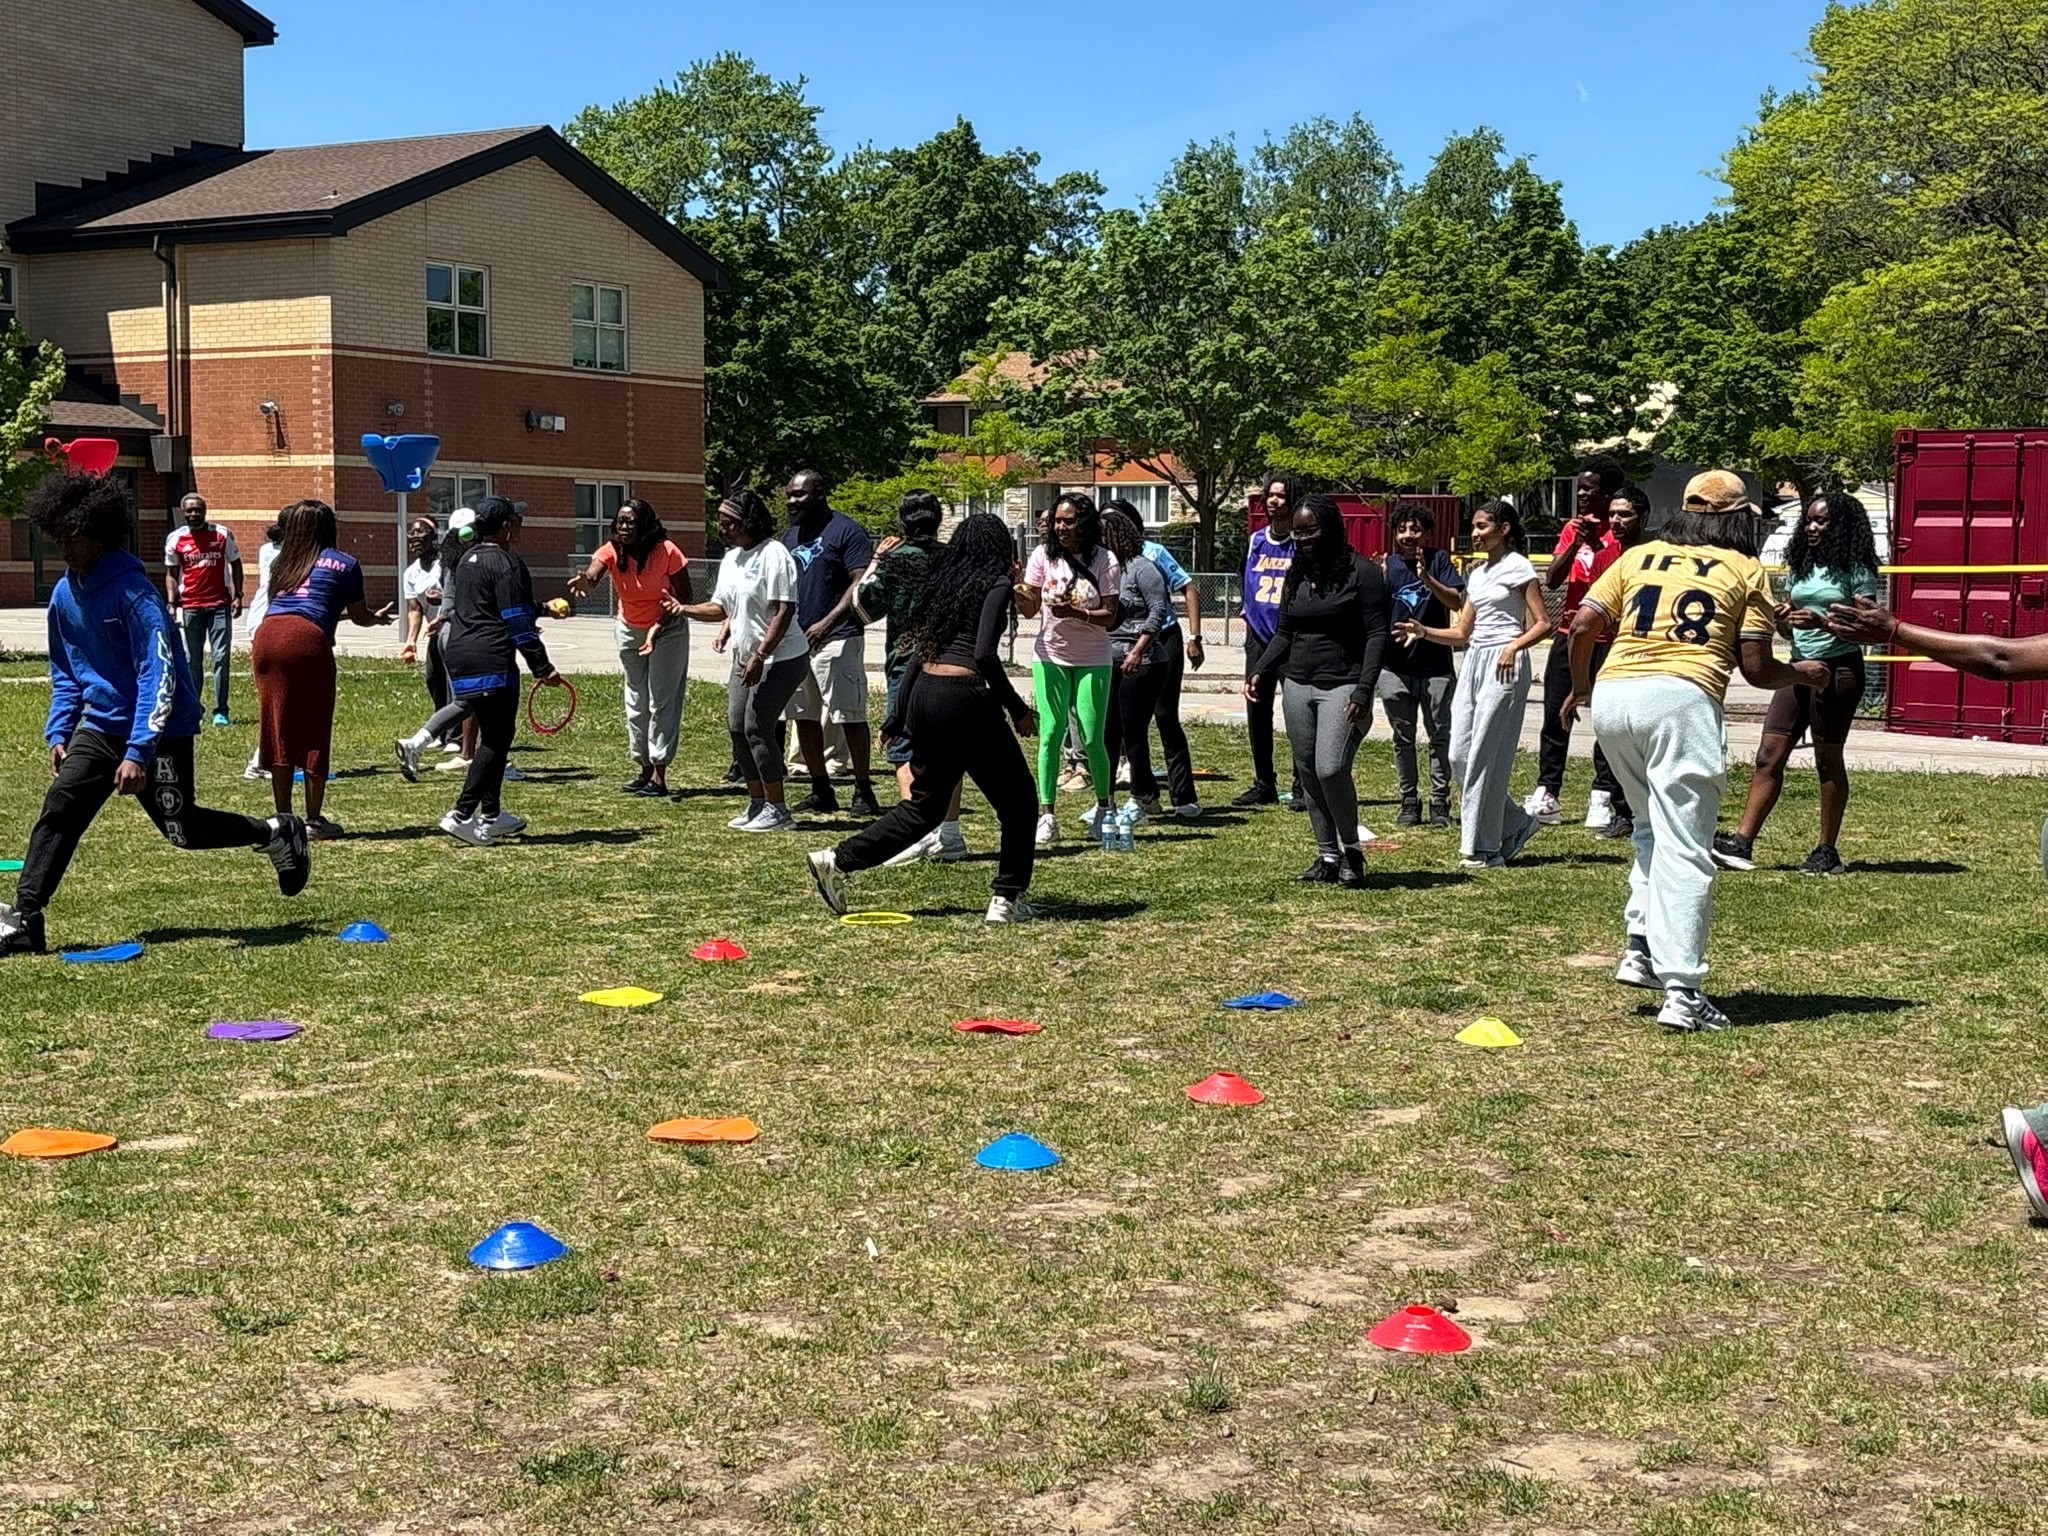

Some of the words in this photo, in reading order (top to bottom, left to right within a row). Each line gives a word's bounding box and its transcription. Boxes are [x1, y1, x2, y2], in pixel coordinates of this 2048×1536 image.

[183, 551, 222, 562] Emirates
[1639, 553, 1722, 577] IFY
[1630, 584, 1715, 645] 18
